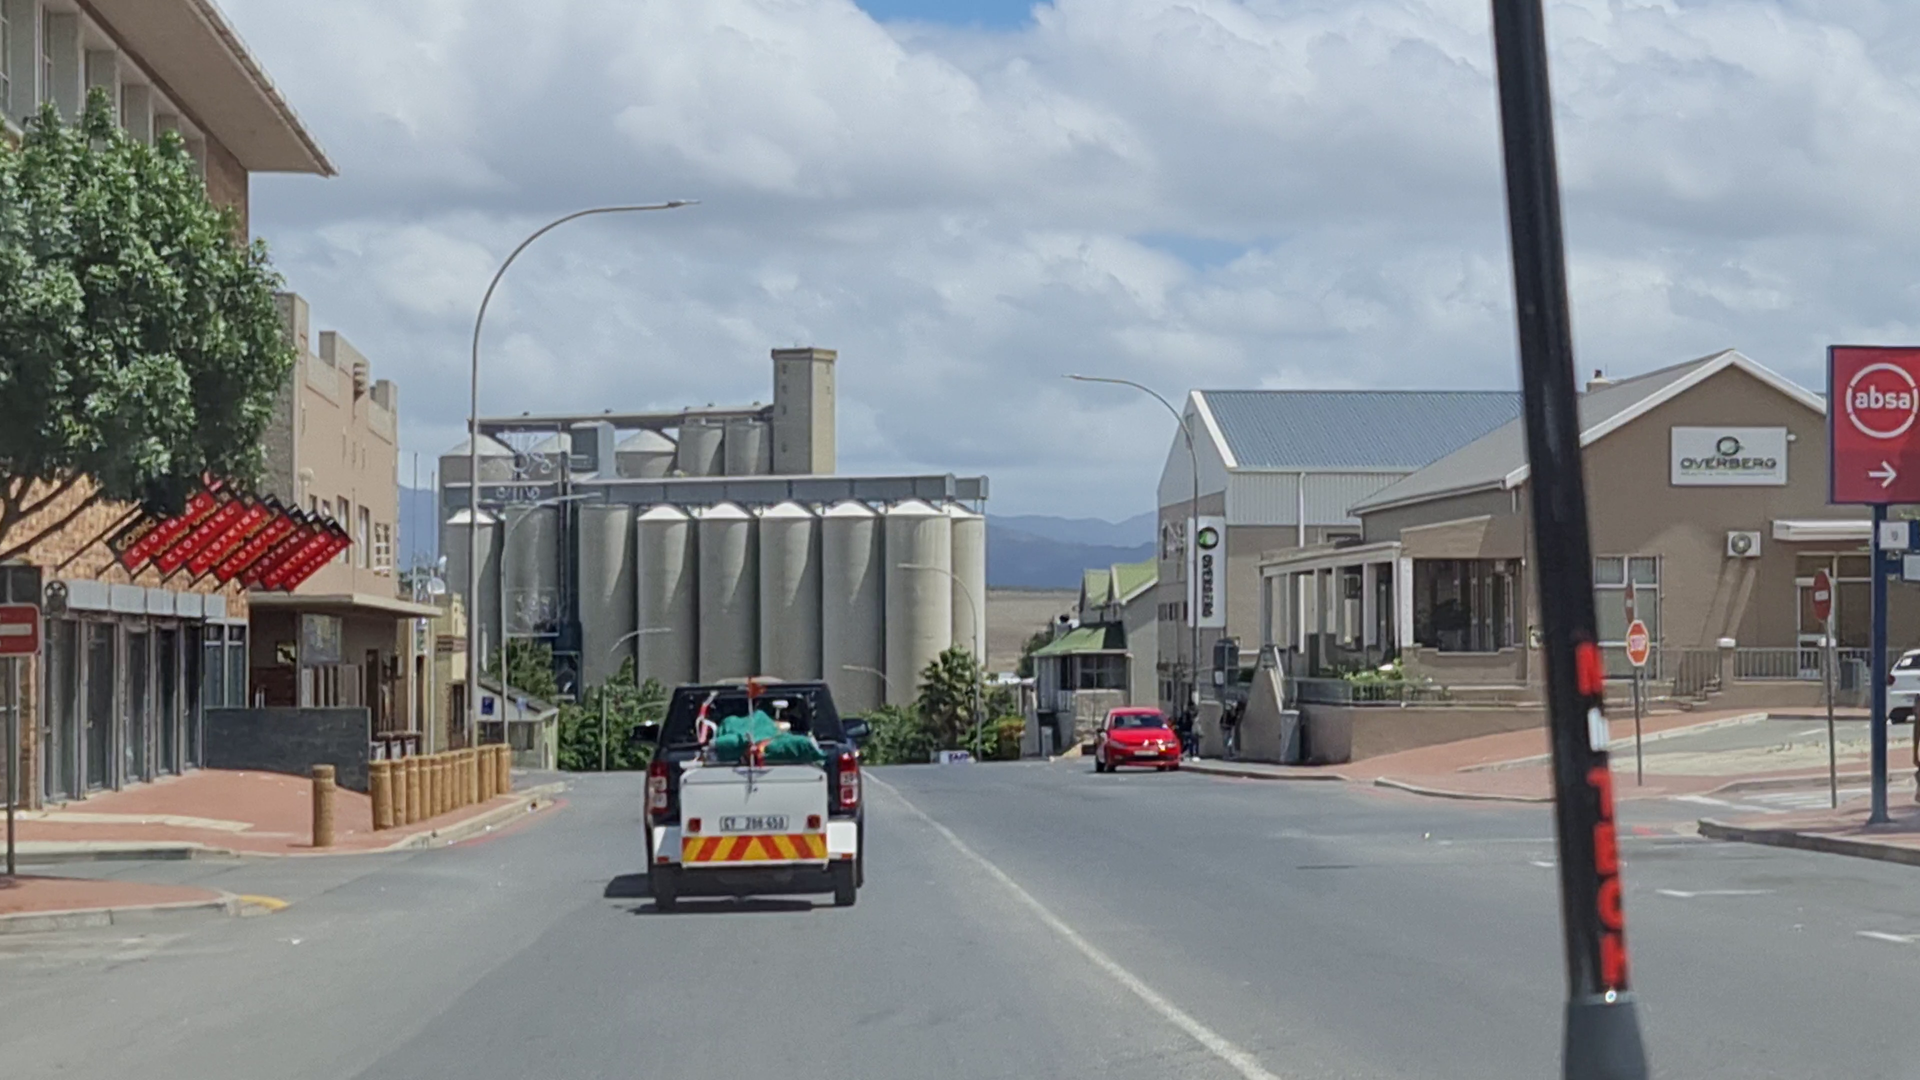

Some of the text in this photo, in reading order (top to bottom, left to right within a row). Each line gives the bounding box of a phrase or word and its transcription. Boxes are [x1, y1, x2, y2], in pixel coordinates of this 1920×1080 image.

[1855, 385, 1911, 409] absa
[1681, 457, 1777, 470] OVERBERG
[165, 505, 235, 564] CLOTHING
[195, 508, 260, 565] CLOTHING
[222, 519, 284, 573] CLOTHING
